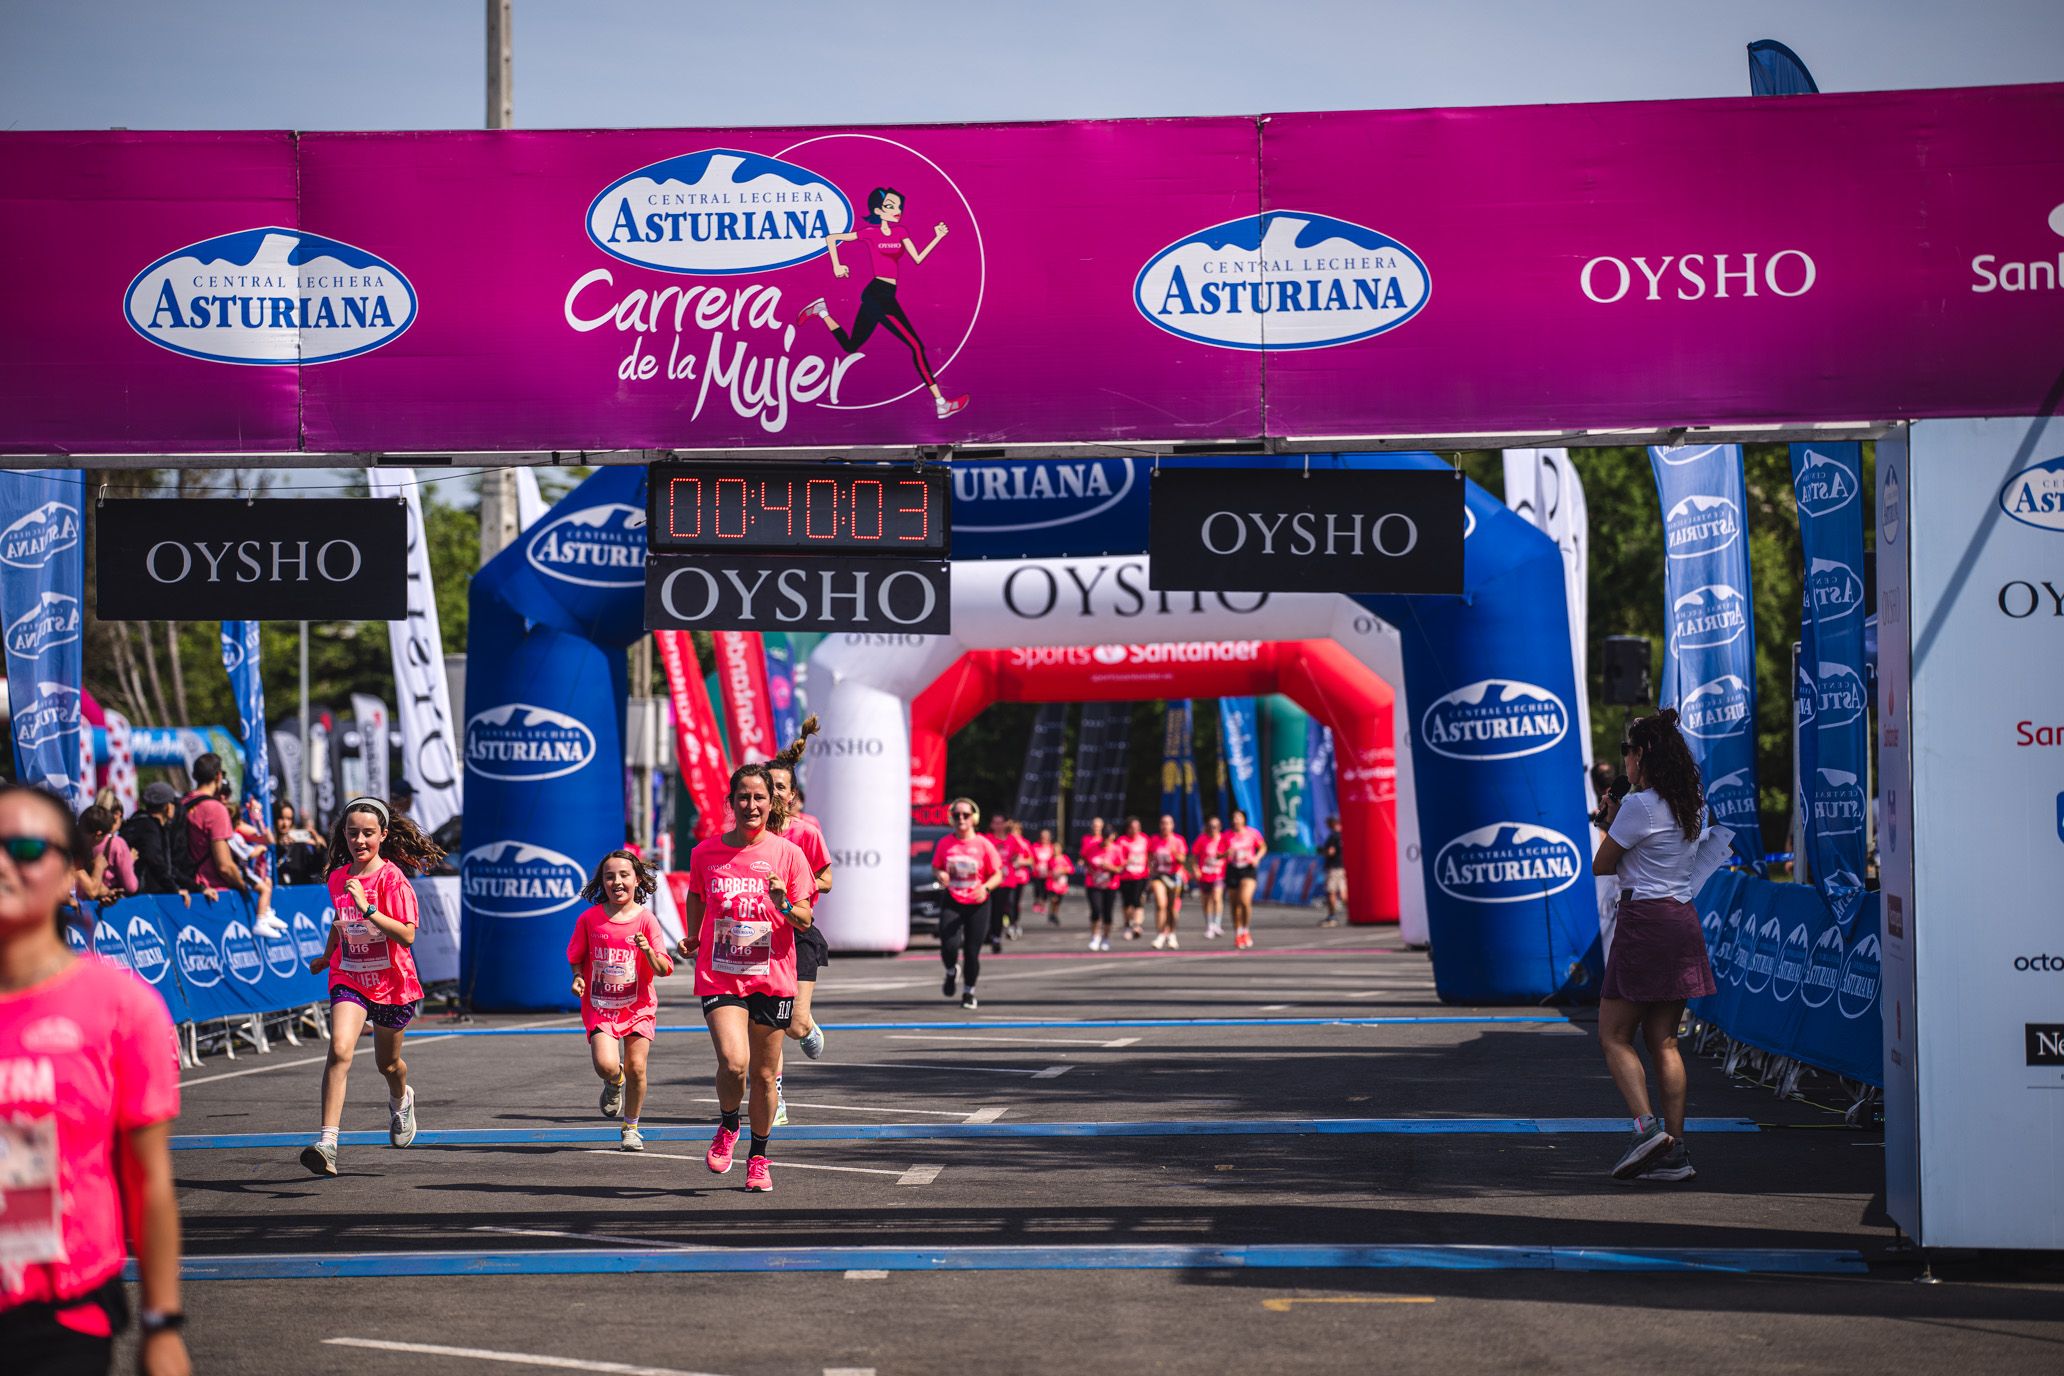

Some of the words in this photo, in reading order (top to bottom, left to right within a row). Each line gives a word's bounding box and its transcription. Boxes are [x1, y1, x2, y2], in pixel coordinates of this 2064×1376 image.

[648, 193, 730, 206] CENTRAL
[740, 191, 824, 204] LECHERA
[607, 197, 831, 243] ASTURIANA
[193, 275, 287, 289] CENTRAL
[296, 274, 385, 289] LECHERA
[1203, 259, 1294, 274] CENTRAL
[1304, 256, 1398, 271] LECHERA
[1580, 249, 1816, 303] OYSHO
[148, 278, 396, 329] ASTURIANA
[564, 268, 783, 332] Carrera
[1157, 264, 1408, 315] ASTURIANA
[617, 335, 659, 380] de
[667, 334, 697, 380] la
[691, 323, 866, 432] Mujer
[950, 463, 1113, 501] URIANA
[669, 477, 928, 541] 00:40:03
[535, 531, 647, 567] ASTURI
[1201, 511, 1418, 557] OYSHO
[146, 539, 361, 584] OYSHO
[661, 567, 936, 624] OYSHO
[1010, 645, 1092, 669] Sports
[1129, 640, 1263, 664] Santander
[467, 731, 585, 761] ASTURIANA
[1431, 714, 1561, 743] ASTURIANA
[832, 850, 881, 868] SHO
[1443, 855, 1574, 885] ASTURIANA
[463, 866, 576, 898] ASTURIANA
